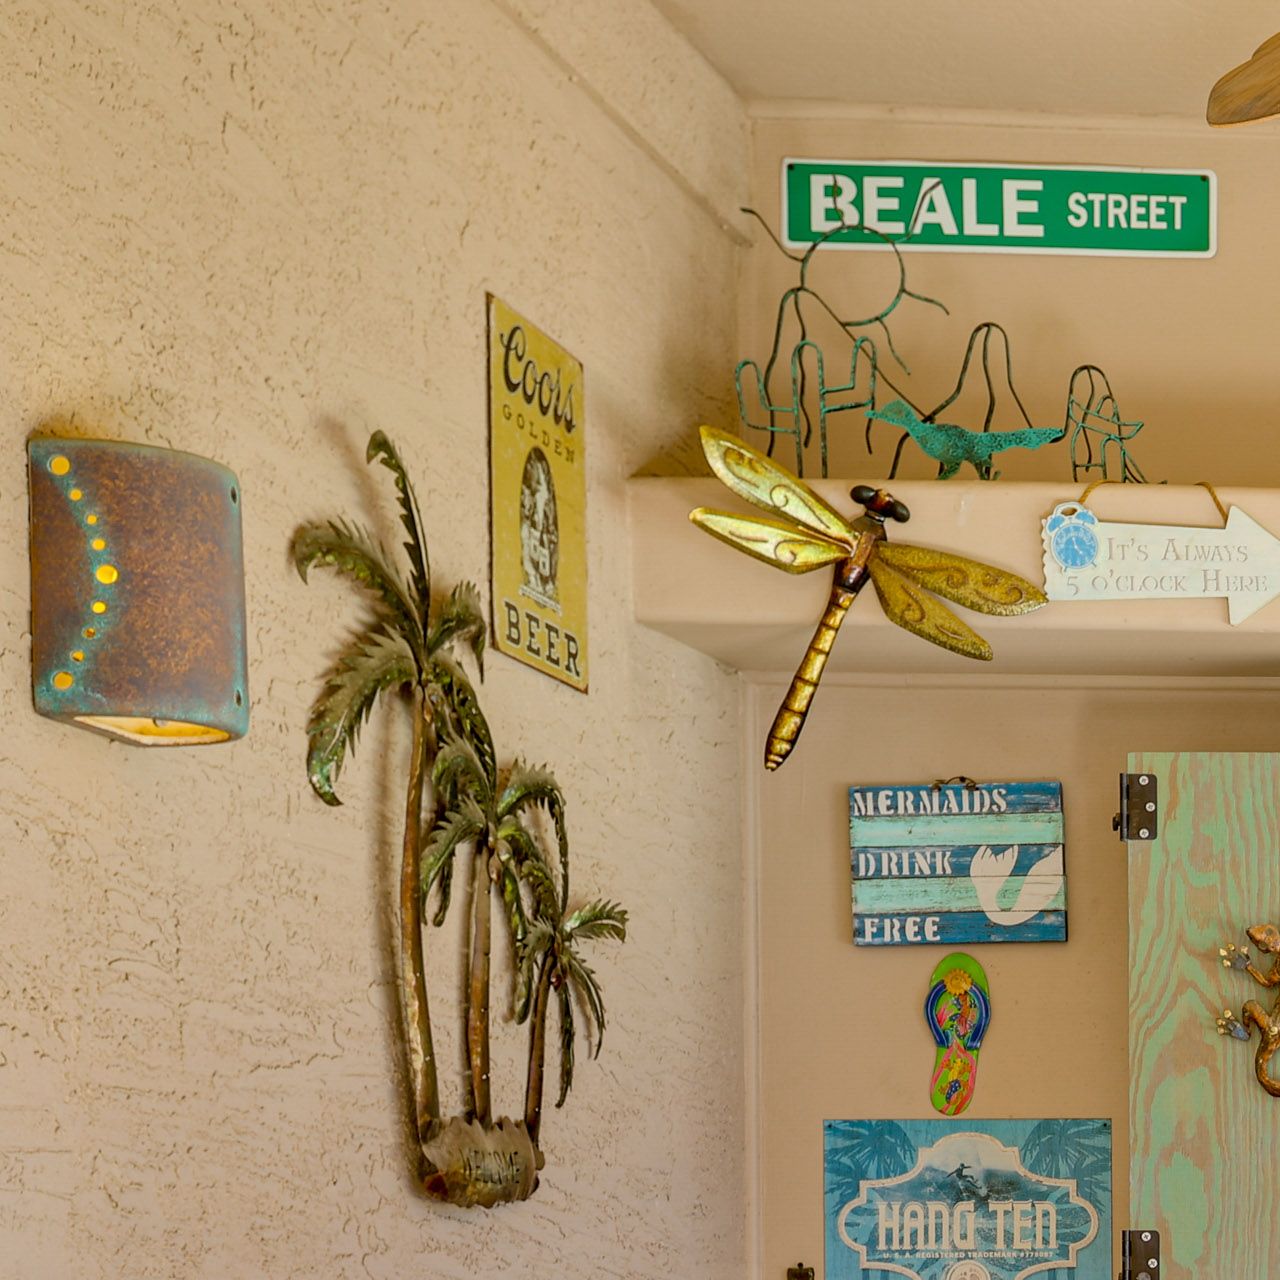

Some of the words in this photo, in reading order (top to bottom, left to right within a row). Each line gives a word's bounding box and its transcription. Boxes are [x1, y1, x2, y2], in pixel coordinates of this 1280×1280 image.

[809, 172, 1044, 238] BEALE
[1067, 191, 1187, 231] STREET
[500, 324, 577, 433] Coors
[502, 402, 575, 465] GOLDEN
[1066, 575, 1080, 597] 5
[504, 599, 581, 678] BEER
[852, 788, 1008, 817] MERMAIDS
[857, 850, 953, 878] DRINK
[863, 915, 941, 943] FREE
[876, 1199, 977, 1251] HANG
[988, 1198, 1060, 1251] TEN
